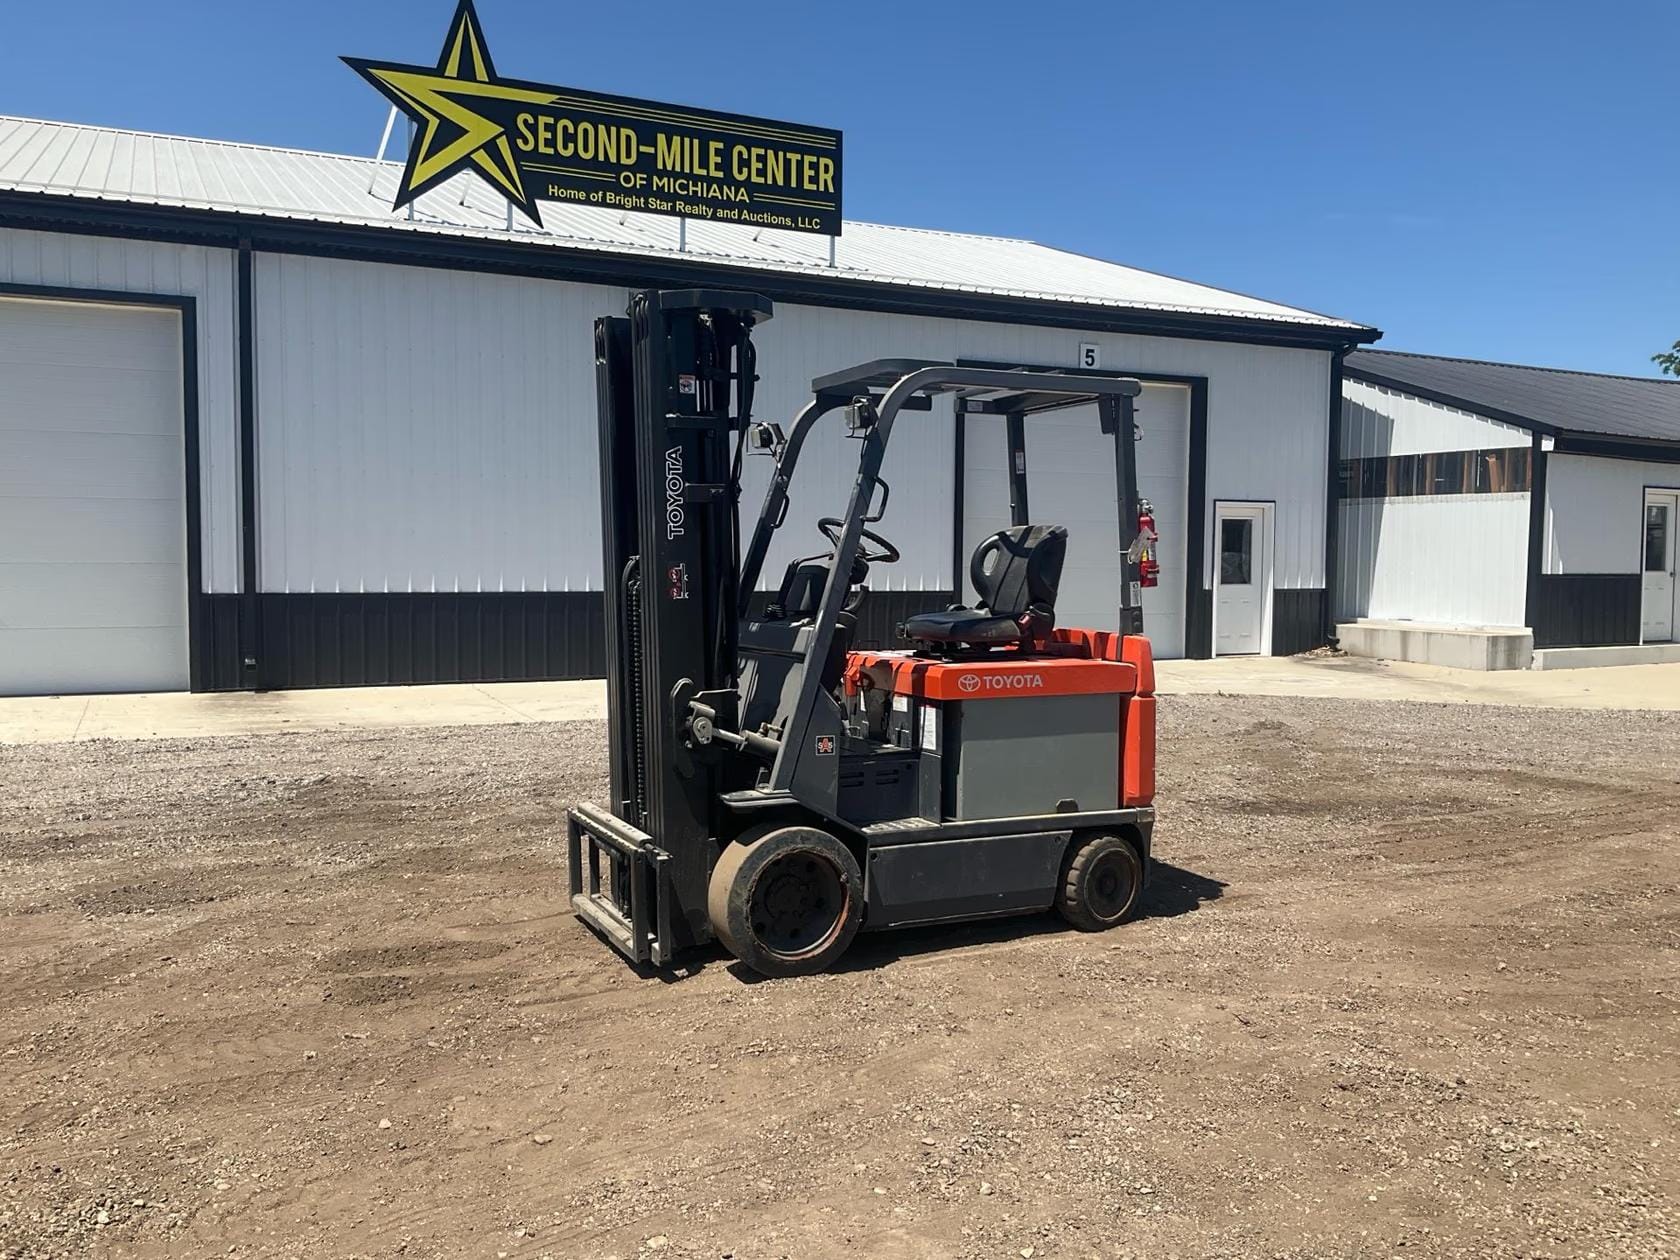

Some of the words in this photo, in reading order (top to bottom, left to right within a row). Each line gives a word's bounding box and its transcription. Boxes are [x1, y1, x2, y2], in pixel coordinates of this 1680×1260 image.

[516, 113, 724, 178] SECOND-MILE
[732, 144, 835, 193] CENTER
[619, 171, 647, 189] OF
[652, 175, 750, 203] MICHIANA
[548, 184, 586, 200] Home
[590, 190, 603, 202] of
[606, 192, 645, 209] Bright
[648, 198, 673, 211] Star
[676, 201, 713, 219] Realty
[716, 208, 738, 220] and
[741, 210, 795, 227] Auctions,
[798, 216, 821, 229] LLC
[1084, 348, 1095, 367] 5
[665, 445, 684, 540] TOYOTA
[983, 673, 1043, 690] TOYOTA
